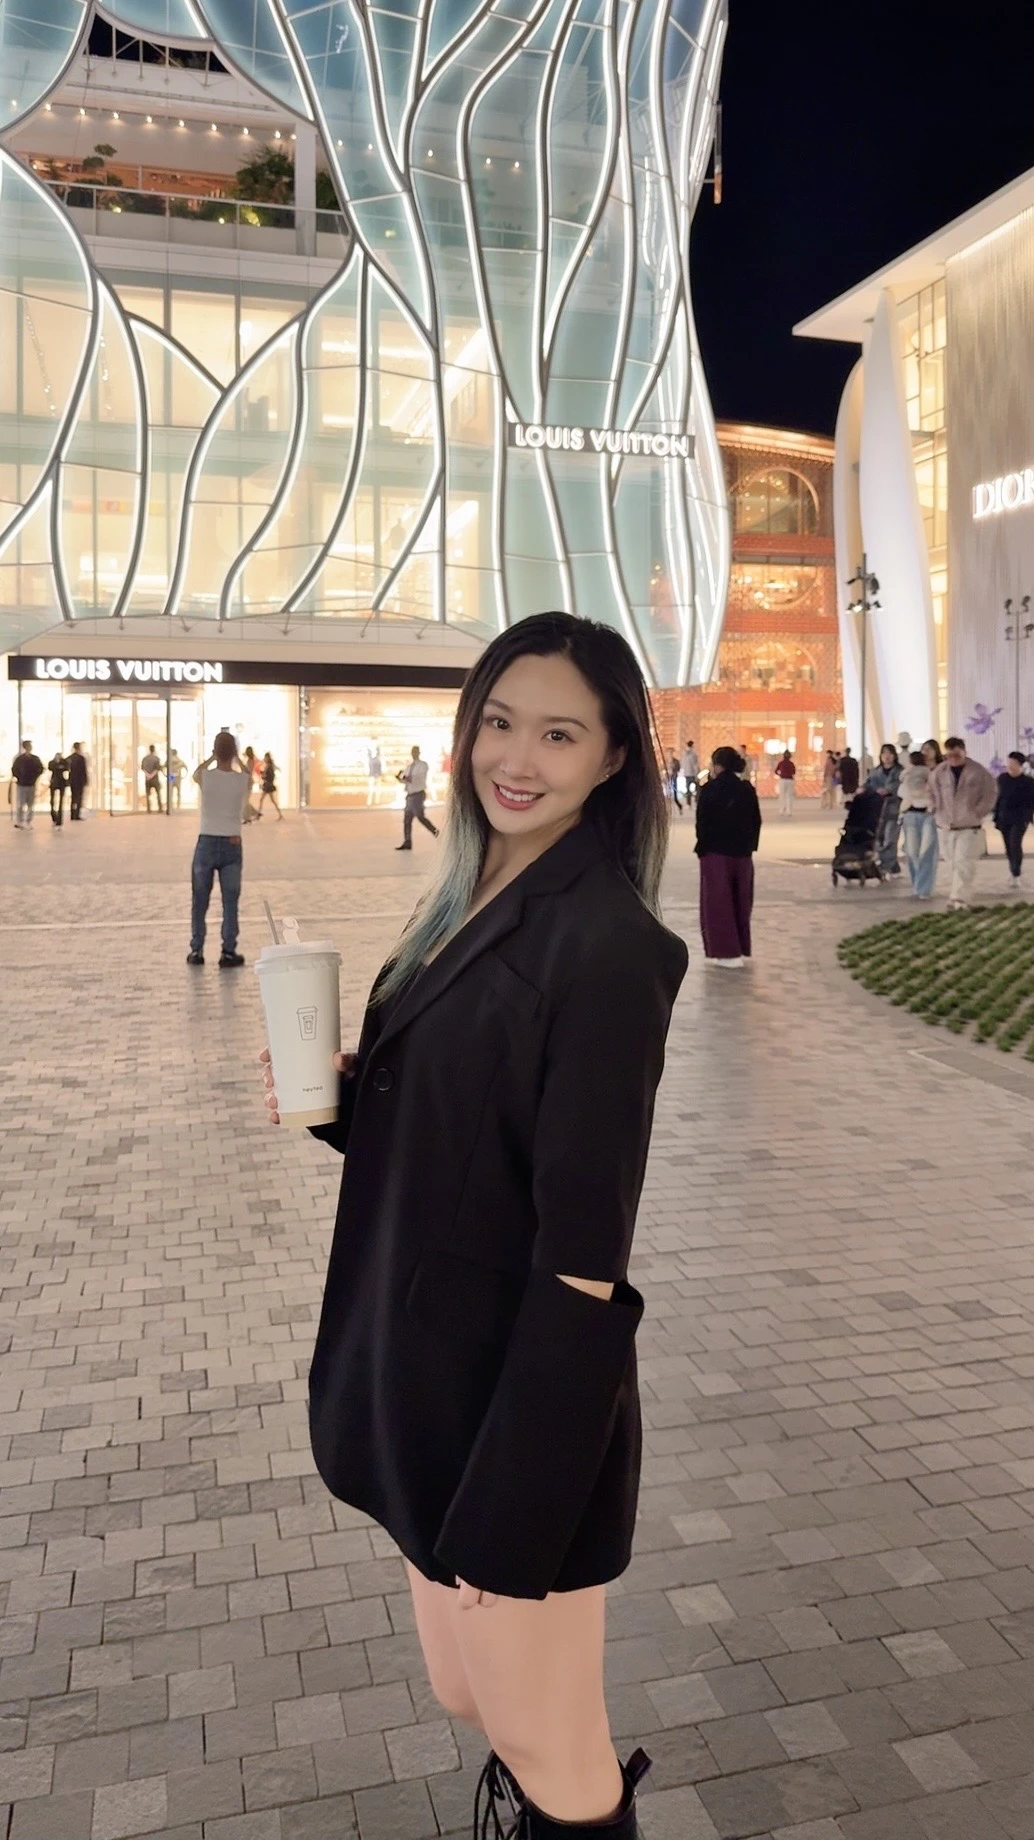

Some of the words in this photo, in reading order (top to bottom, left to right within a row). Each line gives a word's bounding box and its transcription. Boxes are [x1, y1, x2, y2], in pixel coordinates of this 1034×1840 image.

[515, 424, 585, 451] LOUIS
[590, 429, 689, 458] VUITTON
[35, 658, 111, 681] LOUIS
[116, 660, 224, 683] VUITTON
